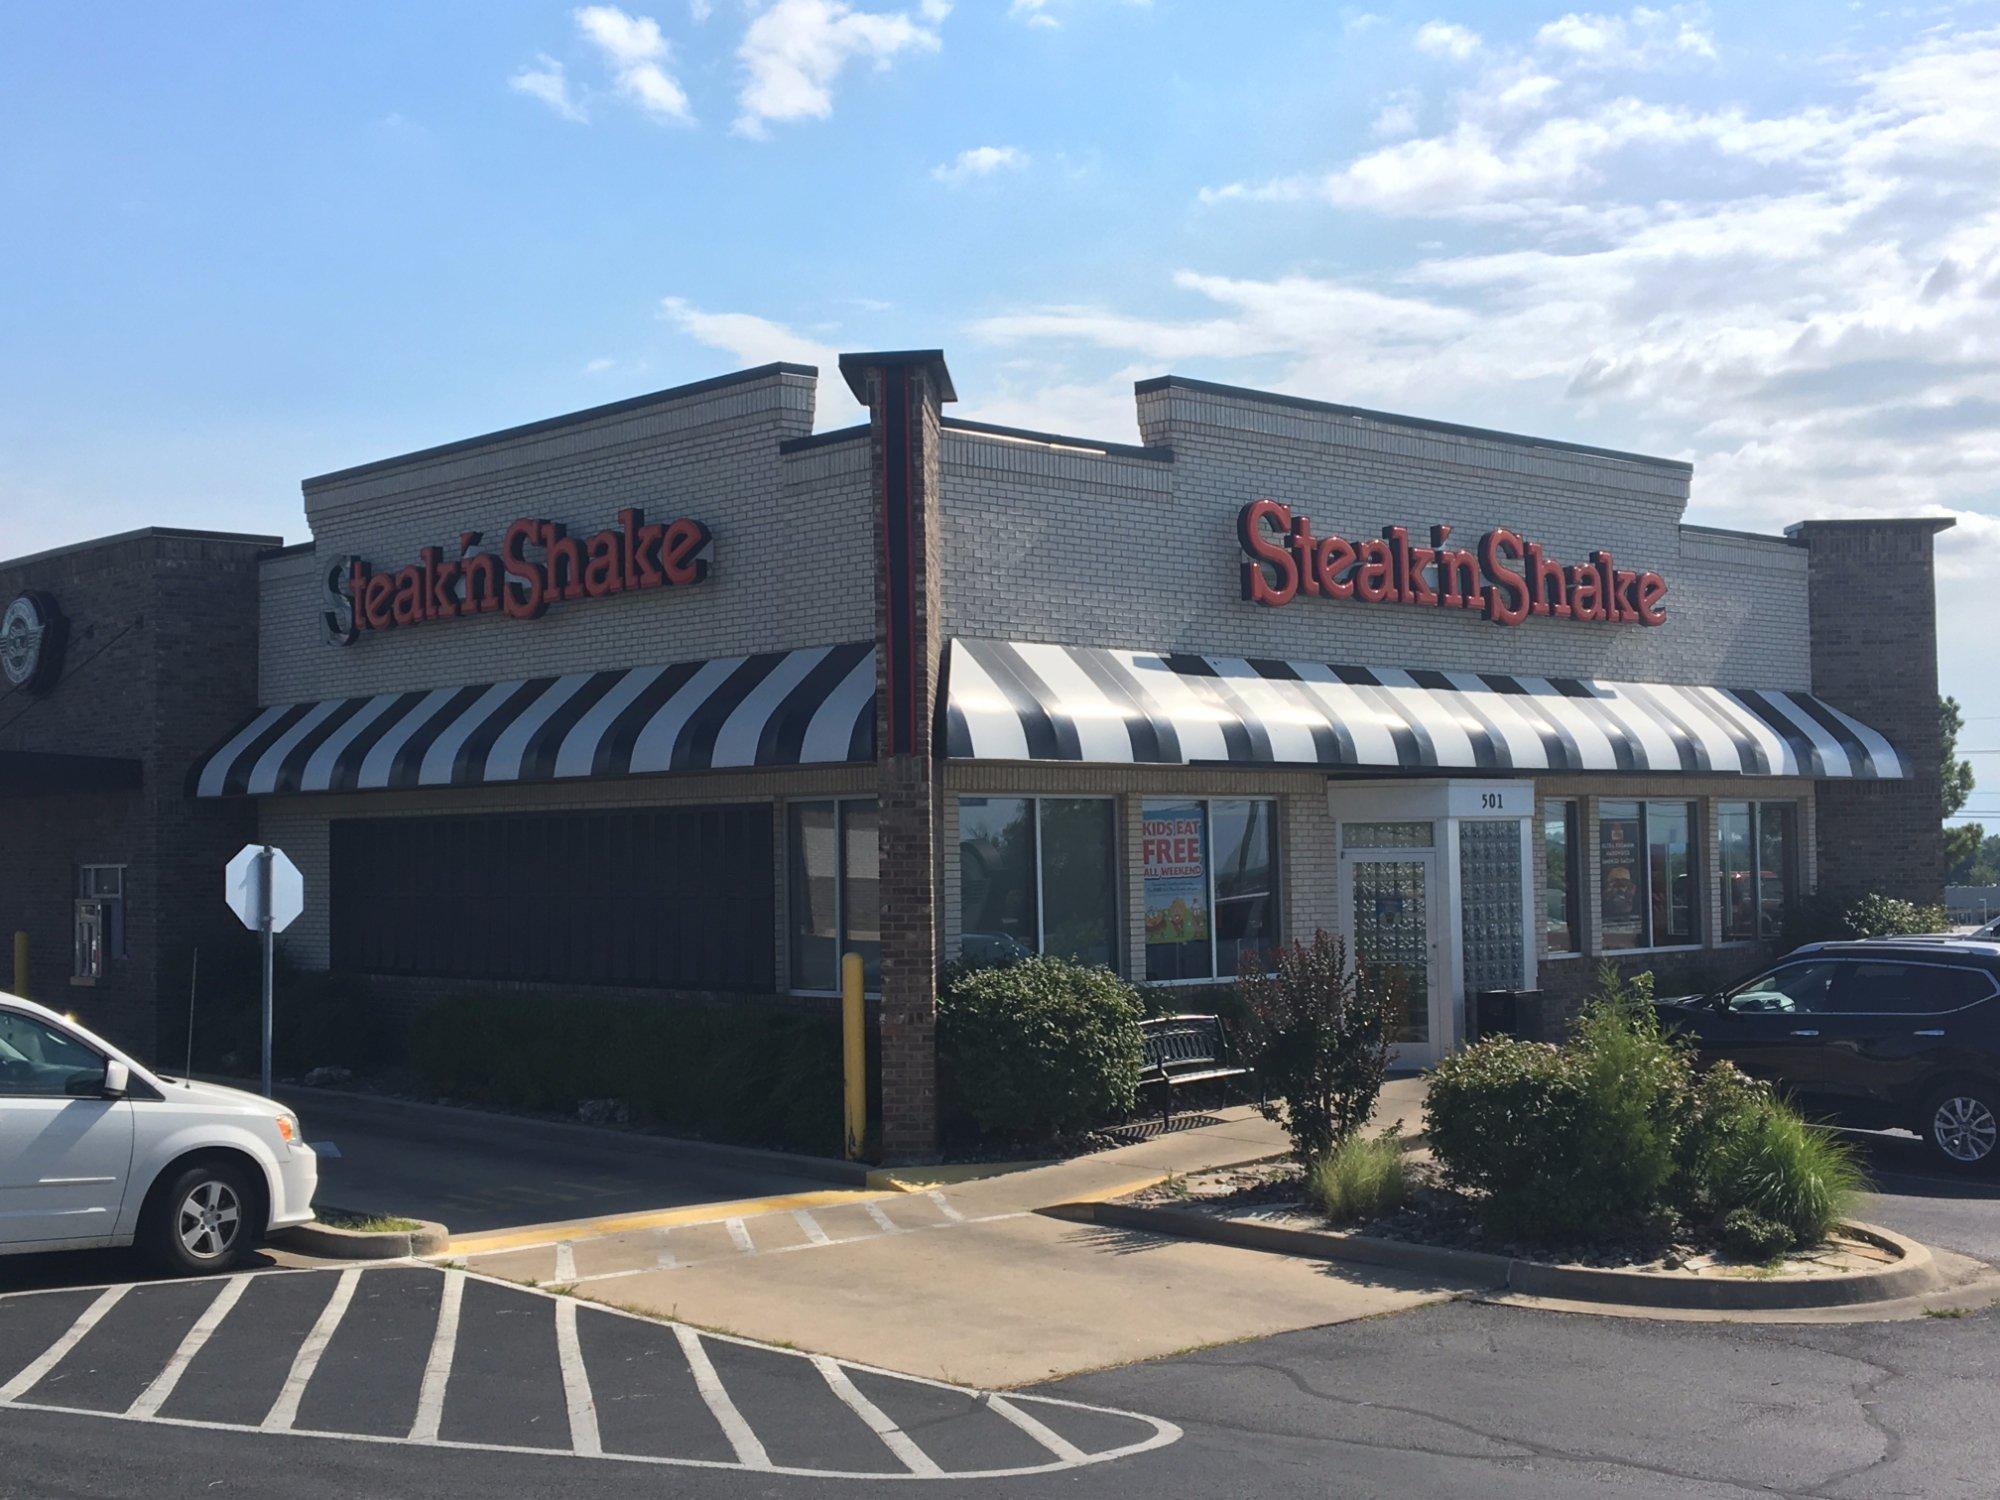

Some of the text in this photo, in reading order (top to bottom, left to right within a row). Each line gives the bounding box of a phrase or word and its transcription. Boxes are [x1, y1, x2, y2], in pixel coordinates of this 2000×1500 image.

[1482, 793, 1503, 809] 501
[1143, 820, 1200, 836] KIDS EAT
[1143, 838, 1200, 865] FREE
[1144, 865, 1202, 877] ALL WEEKEND
